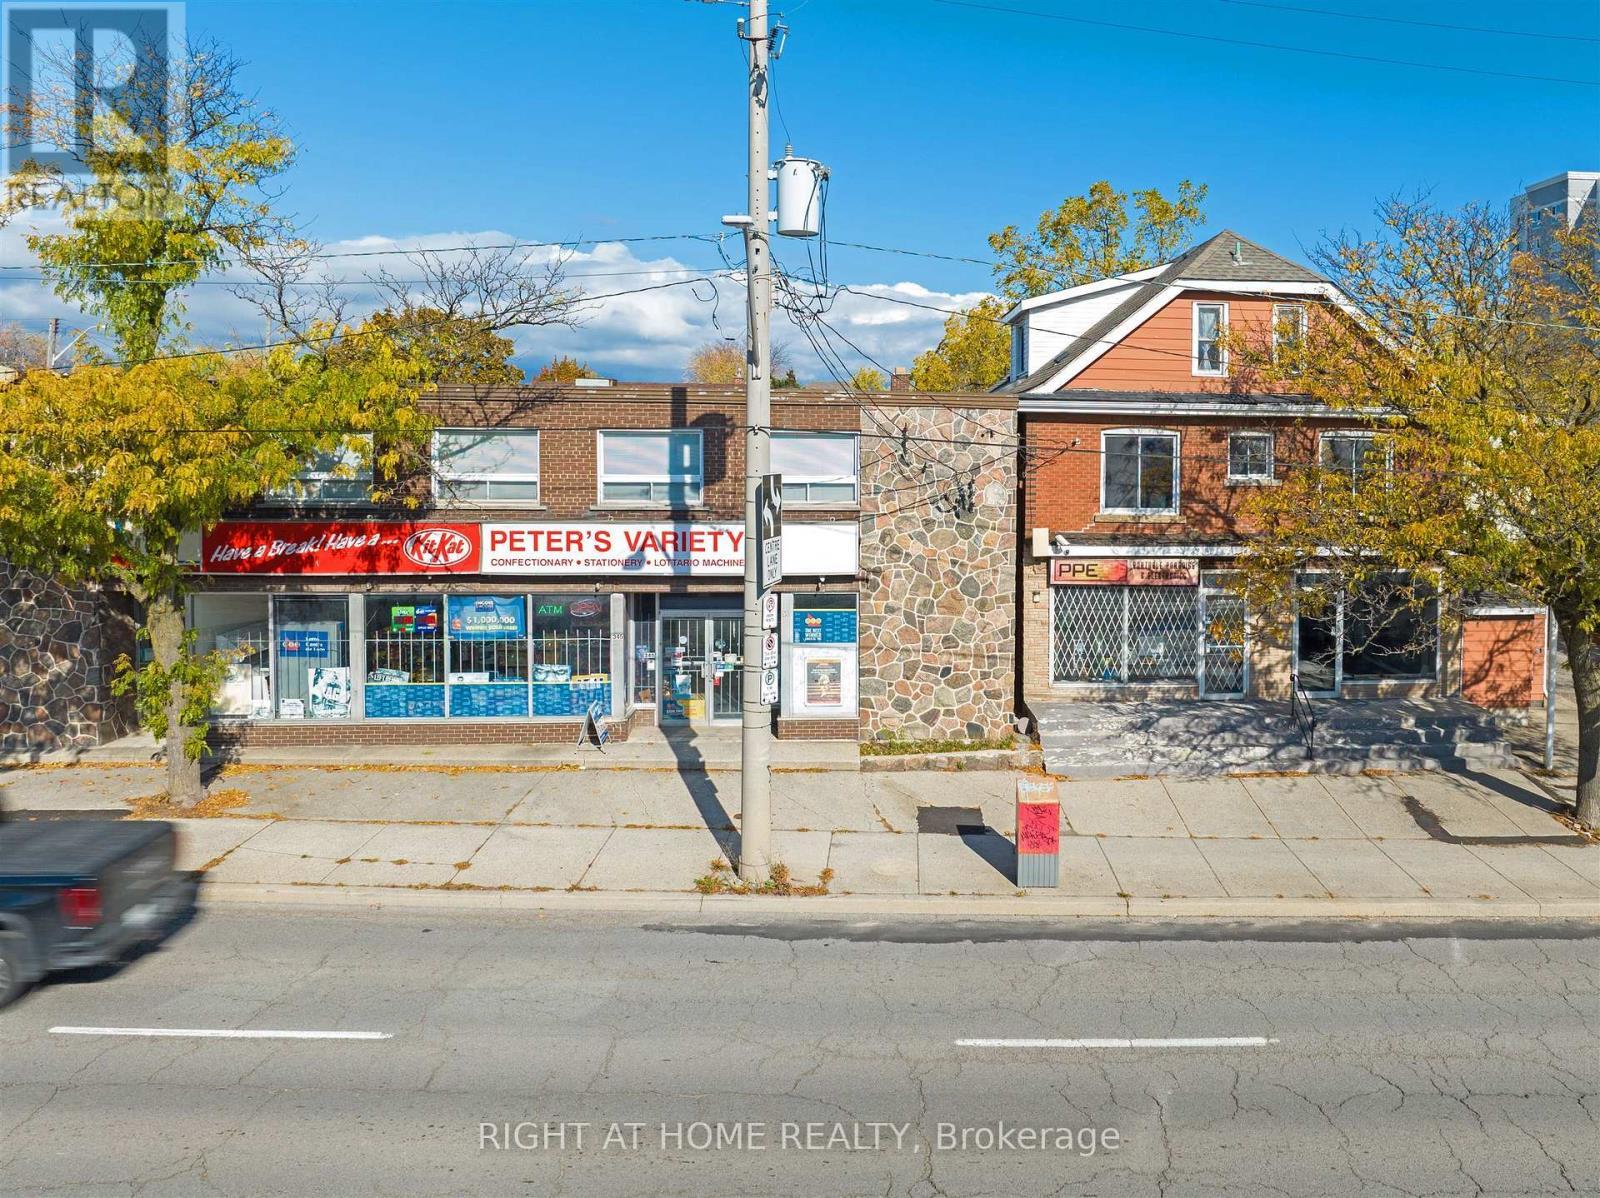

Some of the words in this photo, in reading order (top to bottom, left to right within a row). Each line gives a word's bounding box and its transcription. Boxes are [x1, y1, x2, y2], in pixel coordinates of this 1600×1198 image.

[490, 530, 612, 552] PETER'S
[624, 531, 744, 552] VARIETY
[210, 545, 251, 562] Have
[254, 545, 267, 558] a
[268, 535, 326, 557] Break!
[324, 534, 366, 551] Have
[490, 558, 574, 567] CONFECTIONARY
[584, 558, 642, 567] STATIONERY
[654, 559, 700, 567] LOTTARIO
[767, 553, 778, 567] LANE
[1059, 564, 1098, 577] PPE
[538, 605, 563, 614] ATM
[466, 616, 516, 625] $1,000,000
